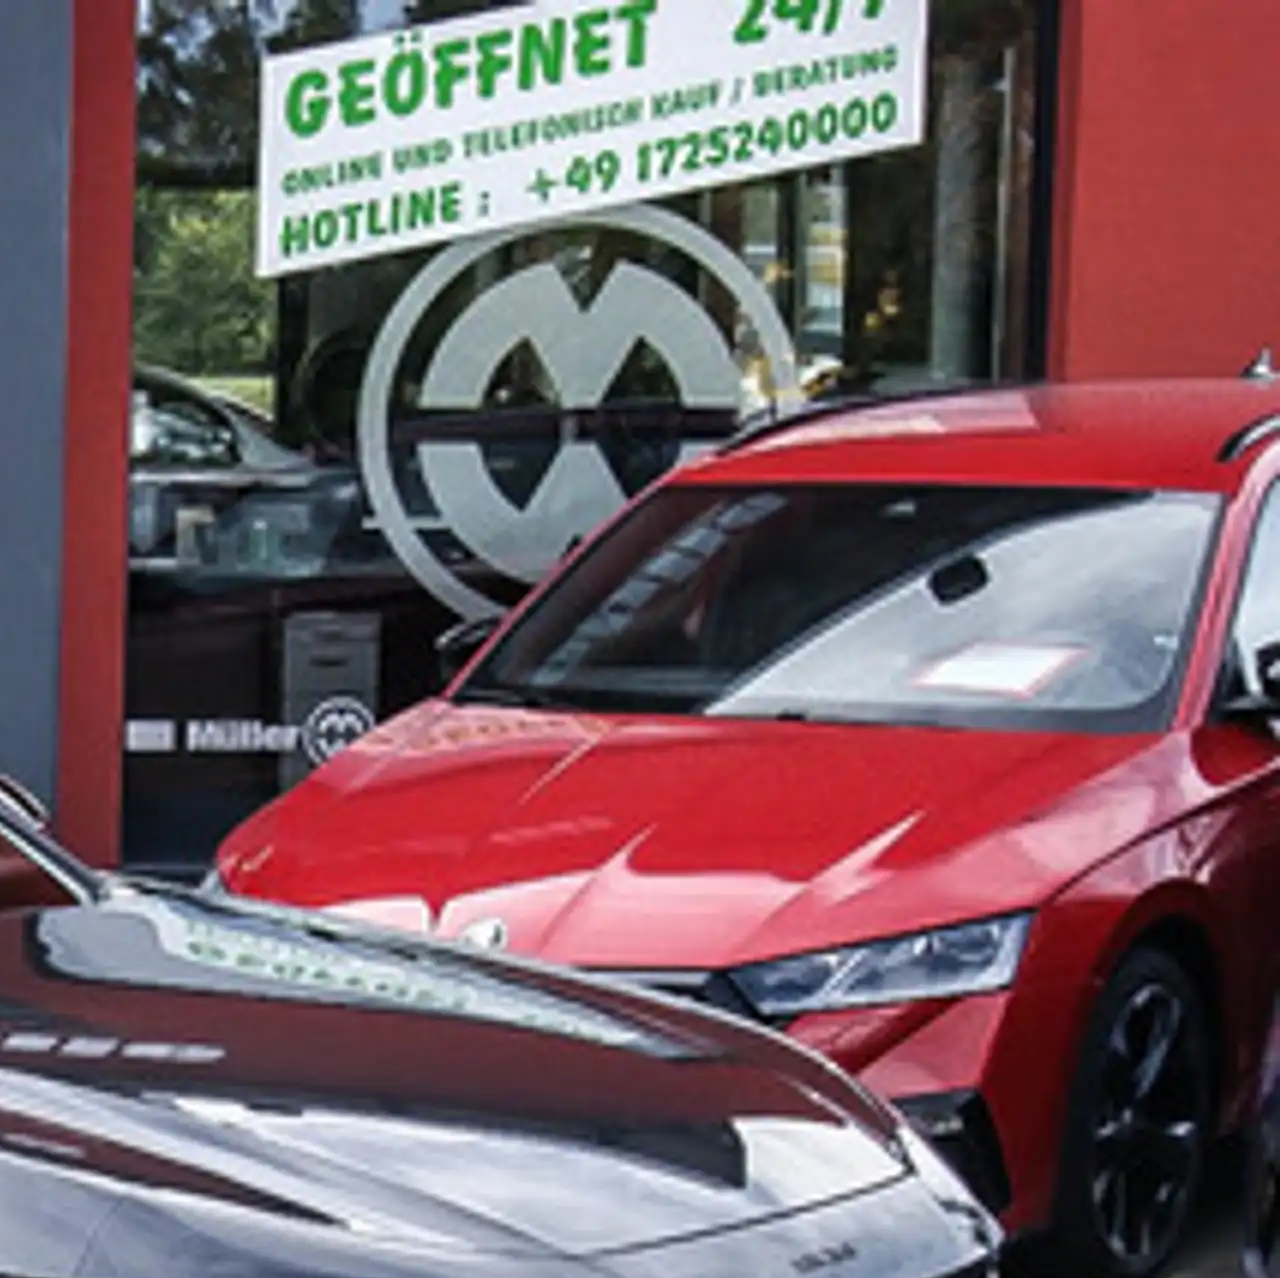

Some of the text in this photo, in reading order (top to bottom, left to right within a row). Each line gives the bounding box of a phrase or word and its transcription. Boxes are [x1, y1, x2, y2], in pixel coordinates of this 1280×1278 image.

[281, 151, 382, 196] ONLINE
[393, 136, 453, 174] UND
[463, 97, 642, 158] TELEFONISCH
[650, 78, 721, 119] KAUF
[752, 44, 898, 98] BERATUNG
[284, 0, 657, 138] GEÖFFNET
[279, 181, 460, 258] HOTLINE
[526, 148, 620, 203] +49
[637, 91, 898, 182] 1725240000
[187, 718, 302, 751] Müller
